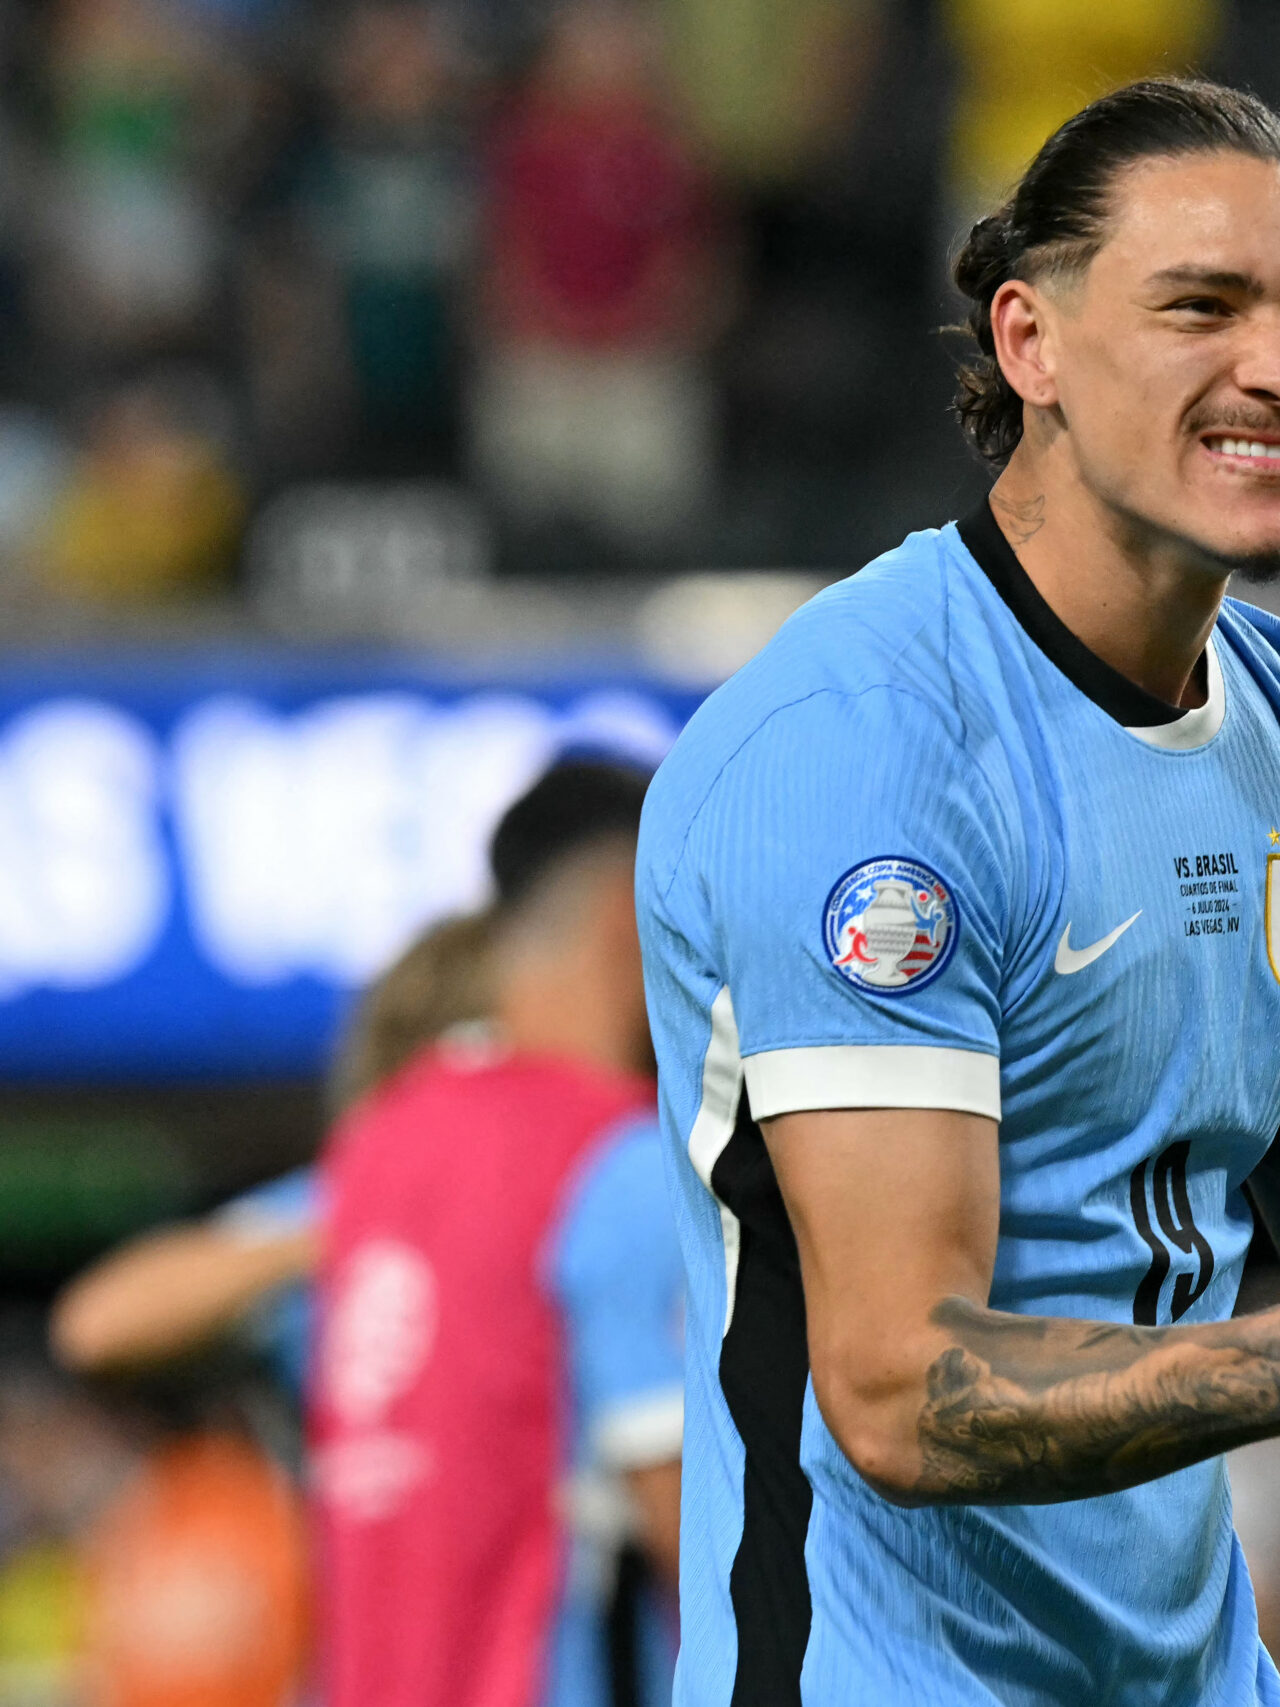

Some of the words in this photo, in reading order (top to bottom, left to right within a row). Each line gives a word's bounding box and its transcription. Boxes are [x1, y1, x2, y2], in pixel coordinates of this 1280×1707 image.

[1173, 857, 1194, 878] VS.
[1196, 852, 1239, 877] BRASIL
[1180, 881, 1209, 897] CUARTOS
[1209, 881, 1218, 894] DE
[1218, 880, 1238, 893] FINAL
[1192, 902, 1196, 914] 6
[1198, 900, 1213, 914] JULIO
[1214, 899, 1230, 912] 2024
[1184, 920, 1200, 936] LAS
[1201, 918, 1225, 935] VEGAS,
[1228, 916, 1240, 932] NV
[1130, 1140, 1214, 1327] 19
